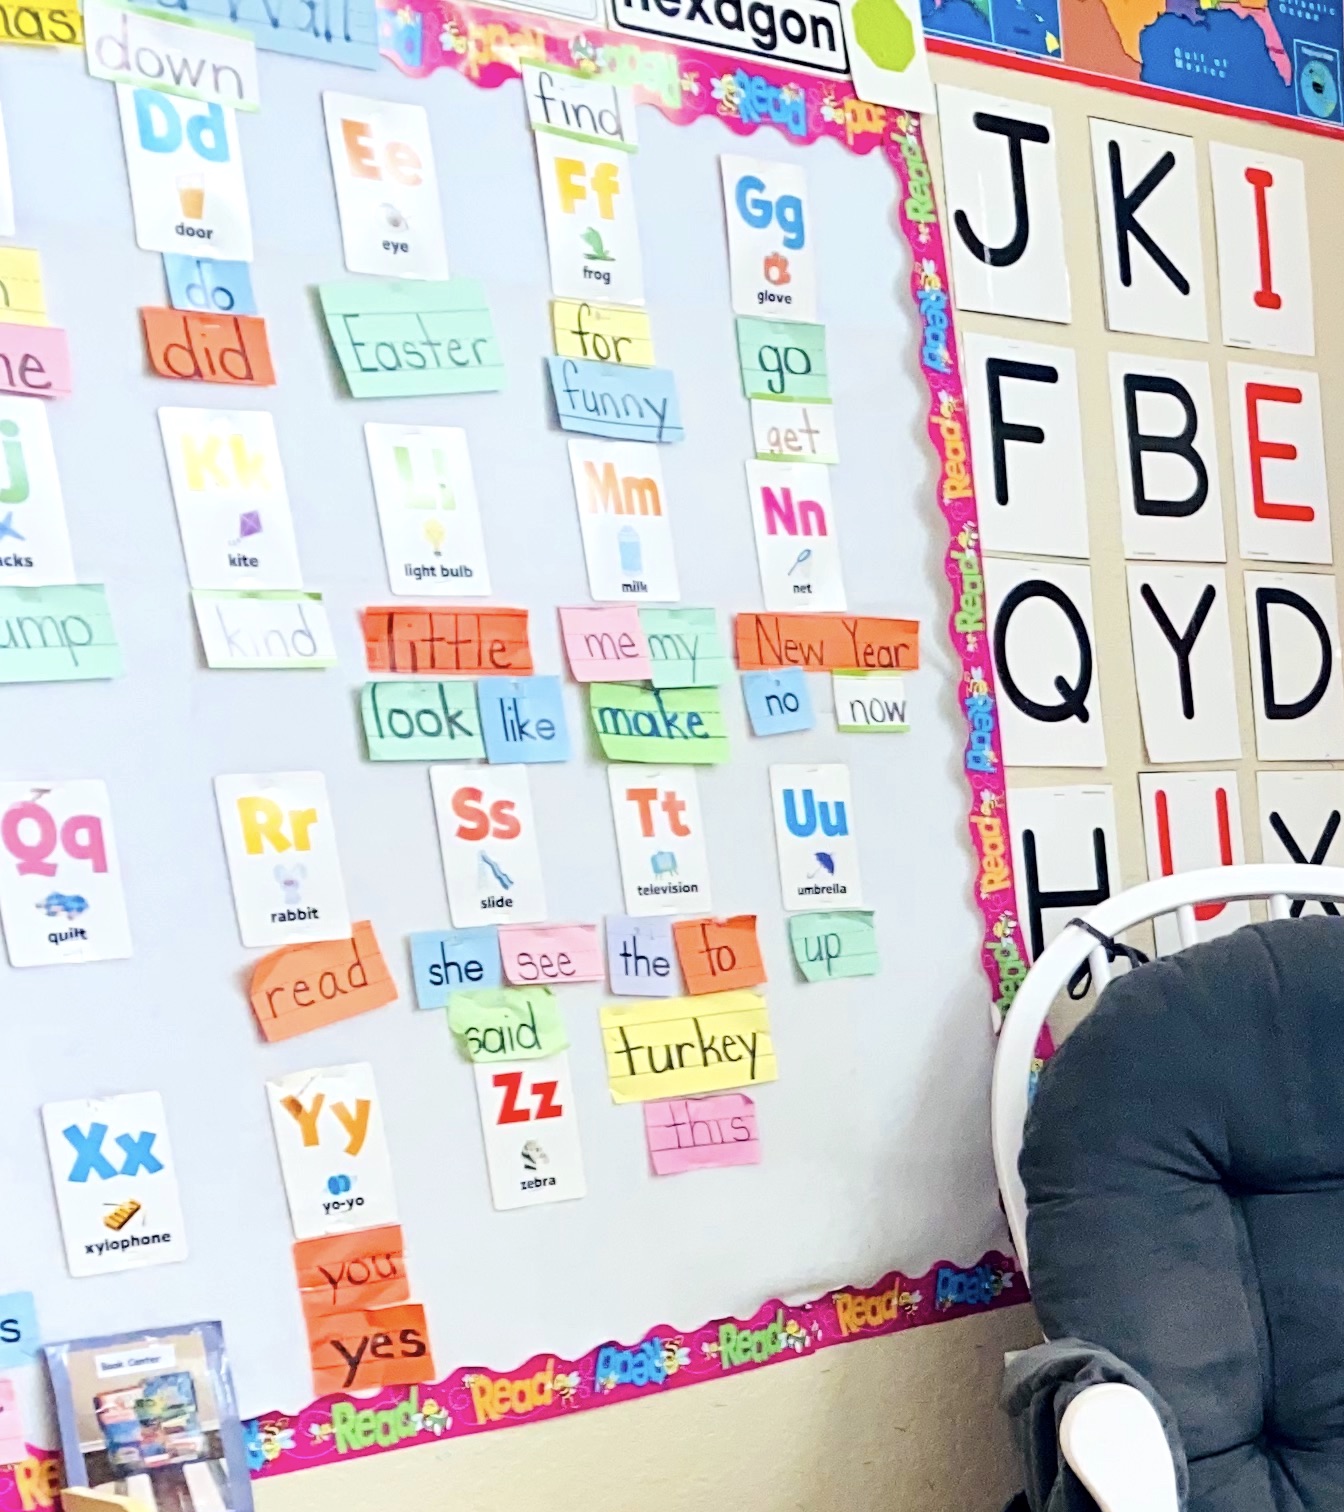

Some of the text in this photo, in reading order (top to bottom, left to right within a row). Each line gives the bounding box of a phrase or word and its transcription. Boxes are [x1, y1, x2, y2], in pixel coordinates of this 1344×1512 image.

[96, 12, 246, 100] down
[133, 89, 230, 162] Dd
[534, 72, 624, 140] find
[341, 118, 423, 187] Ee
[896, 133, 937, 223] Read
[554, 157, 620, 221] Ff
[735, 176, 805, 249] Gg
[953, 111, 1050, 267] J
[175, 223, 214, 241] door
[1109, 140, 1190, 295] K
[1244, 167, 1281, 309] I
[382, 240, 410, 255] eye
[186, 261, 235, 311] do
[583, 266, 612, 284] frog
[758, 291, 792, 306] glove
[164, 314, 254, 381] did
[343, 313, 488, 373] Easter
[571, 303, 633, 363] for
[759, 344, 811, 393] go
[562, 360, 668, 441] funny
[766, 408, 820, 454] get
[936, 412, 974, 500] Read
[986, 358, 1058, 506] F
[1124, 373, 1208, 517] B
[1246, 382, 1314, 521] E
[0, 419, 30, 503] j
[181, 435, 270, 492] Kk
[583, 462, 661, 516] Mm
[761, 487, 827, 537] Nn
[228, 554, 259, 568] kite
[405, 564, 473, 580] light bulb
[622, 580, 648, 594] milk
[793, 584, 812, 595] net
[949, 550, 985, 634] Read
[217, 604, 317, 656] kind
[387, 612, 513, 672] little
[584, 630, 640, 659] me
[755, 616, 910, 670] New Year
[994, 579, 1092, 723] Q
[1140, 583, 1216, 719] Y
[1256, 587, 1332, 720] D
[648, 633, 698, 683] my
[371, 682, 473, 740] look
[499, 697, 556, 743] like
[600, 680, 708, 739] make
[766, 691, 799, 716] no
[850, 697, 907, 724] now
[2, 800, 109, 878] Qq
[237, 795, 318, 855] Rr
[451, 787, 521, 841] Ss
[626, 788, 691, 838] Tt
[783, 788, 849, 838] Uu
[970, 814, 1011, 893] Read
[271, 906, 319, 923] rabbit
[481, 896, 514, 910] slide
[637, 882, 699, 897] television
[798, 883, 847, 896] umbrella
[48, 926, 88, 945] quilt
[620, 936, 669, 979] the
[699, 923, 736, 976] to
[804, 933, 842, 975] up
[265, 937, 369, 1020] read
[429, 941, 484, 986] she
[517, 950, 576, 979] see
[464, 1002, 542, 1055] said
[614, 1017, 758, 1079] turkey
[280, 1093, 371, 1156] Yy
[492, 1072, 563, 1124] Zz
[667, 1101, 750, 1149] this
[62, 1122, 164, 1182] Xx
[322, 1195, 364, 1214] yo-yo
[521, 1175, 556, 1191] zebra
[85, 1230, 172, 1257] xylophone
[319, 1254, 398, 1304] you
[835, 1278, 900, 1336] Read
[330, 1327, 427, 1389] yes
[718, 1308, 785, 1370] Read
[470, 1358, 557, 1425] Read
[332, 1386, 419, 1454] Read
